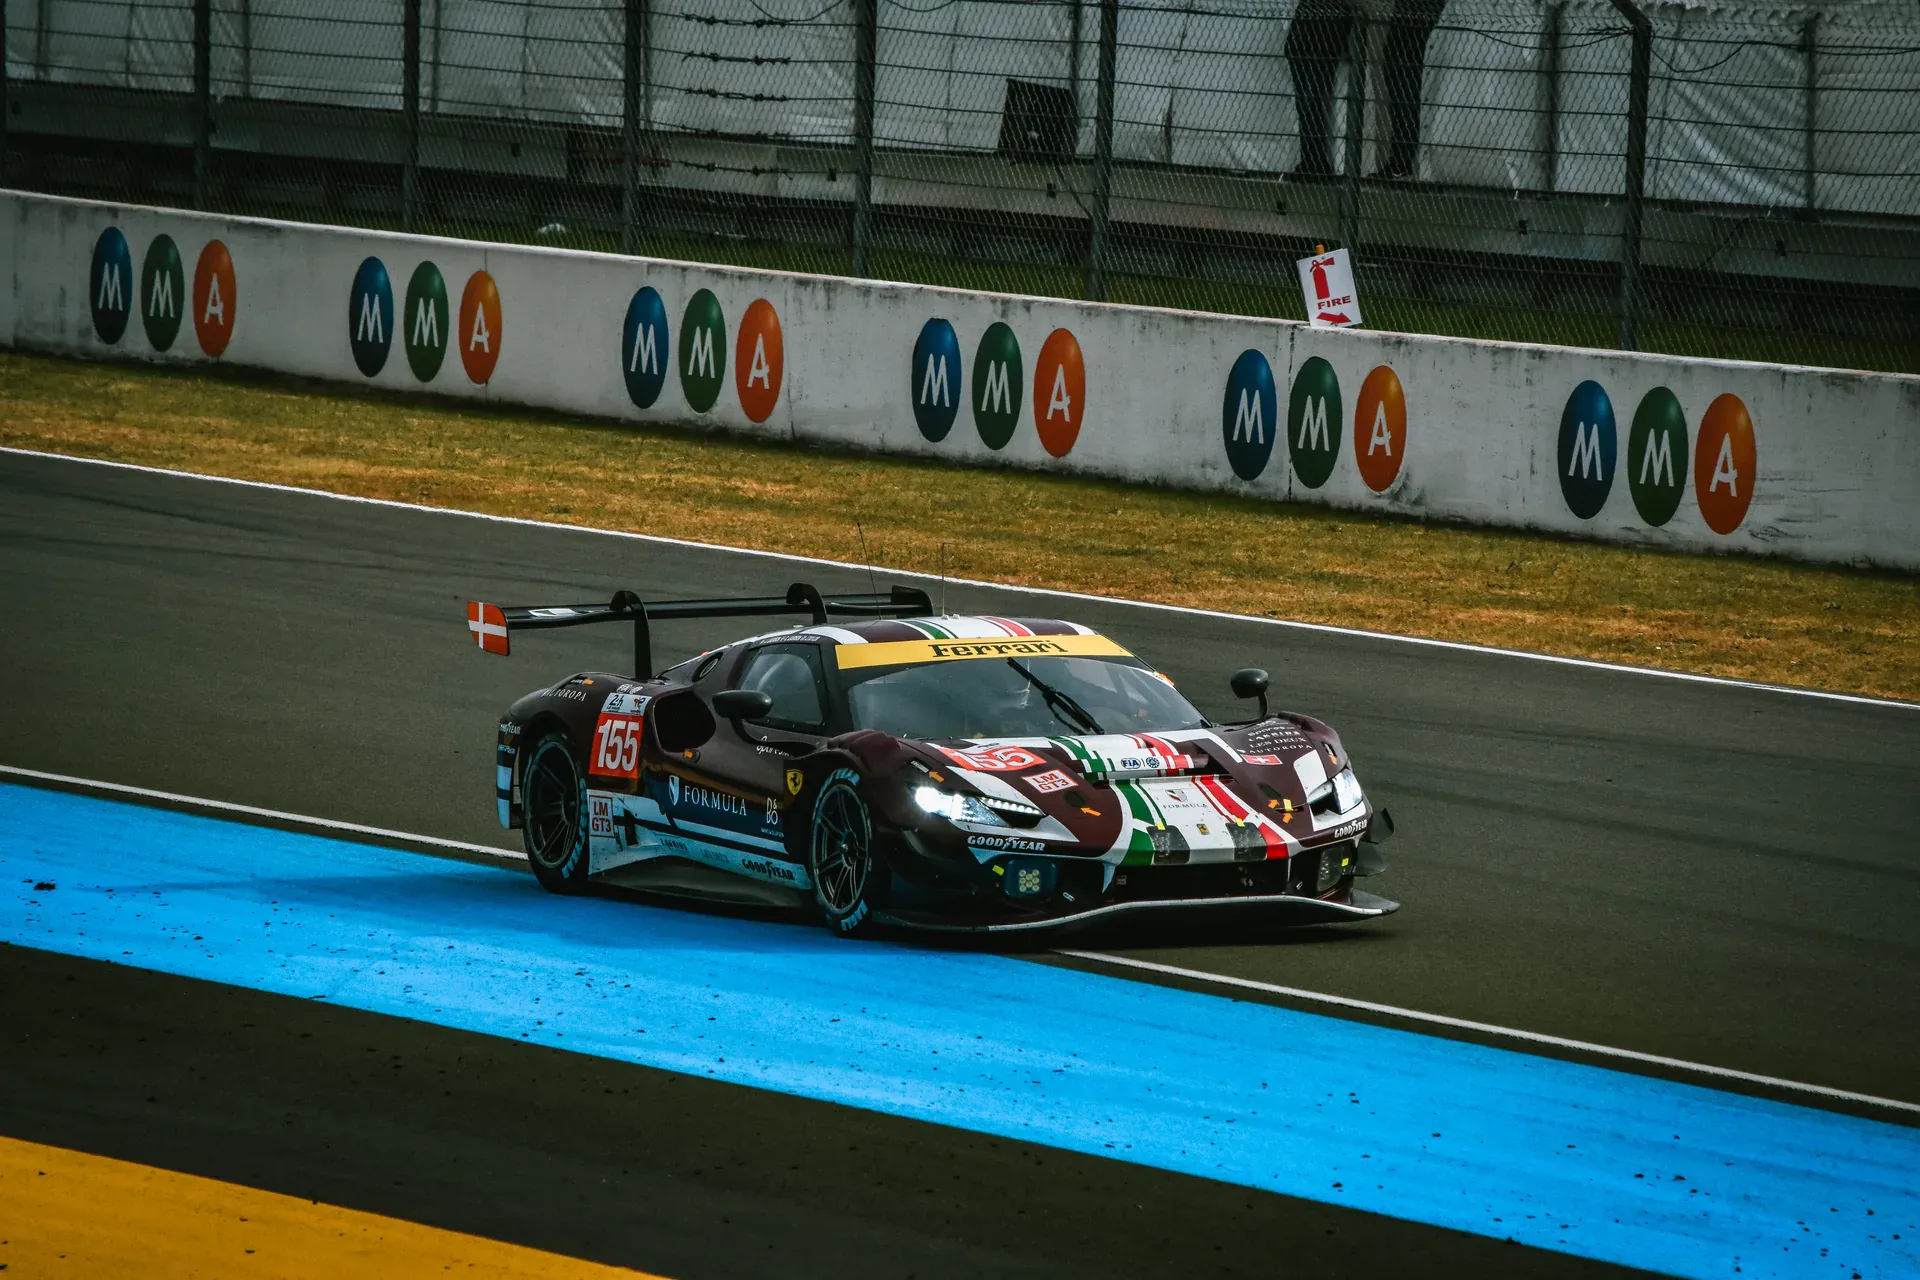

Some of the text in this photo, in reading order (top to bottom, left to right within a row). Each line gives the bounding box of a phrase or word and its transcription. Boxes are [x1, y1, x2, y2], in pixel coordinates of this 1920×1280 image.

[1317, 295, 1351, 310] FIRE
[928, 639, 1068, 658] Ferrari
[597, 719, 640, 772] 155
[1250, 745, 1313, 754] AUTOROPA
[949, 747, 1035, 769] 155
[1122, 759, 1139, 767] FIA
[1033, 772, 1057, 784] LM
[1039, 779, 1071, 792] GT3
[593, 801, 608, 816] LM
[684, 785, 747, 817] FORMULA
[592, 816, 611, 832] GT3
[1334, 819, 1368, 838] GOODYEAR
[967, 835, 1046, 852] GOODYEAR
[742, 859, 795, 881] GOODYEAR
